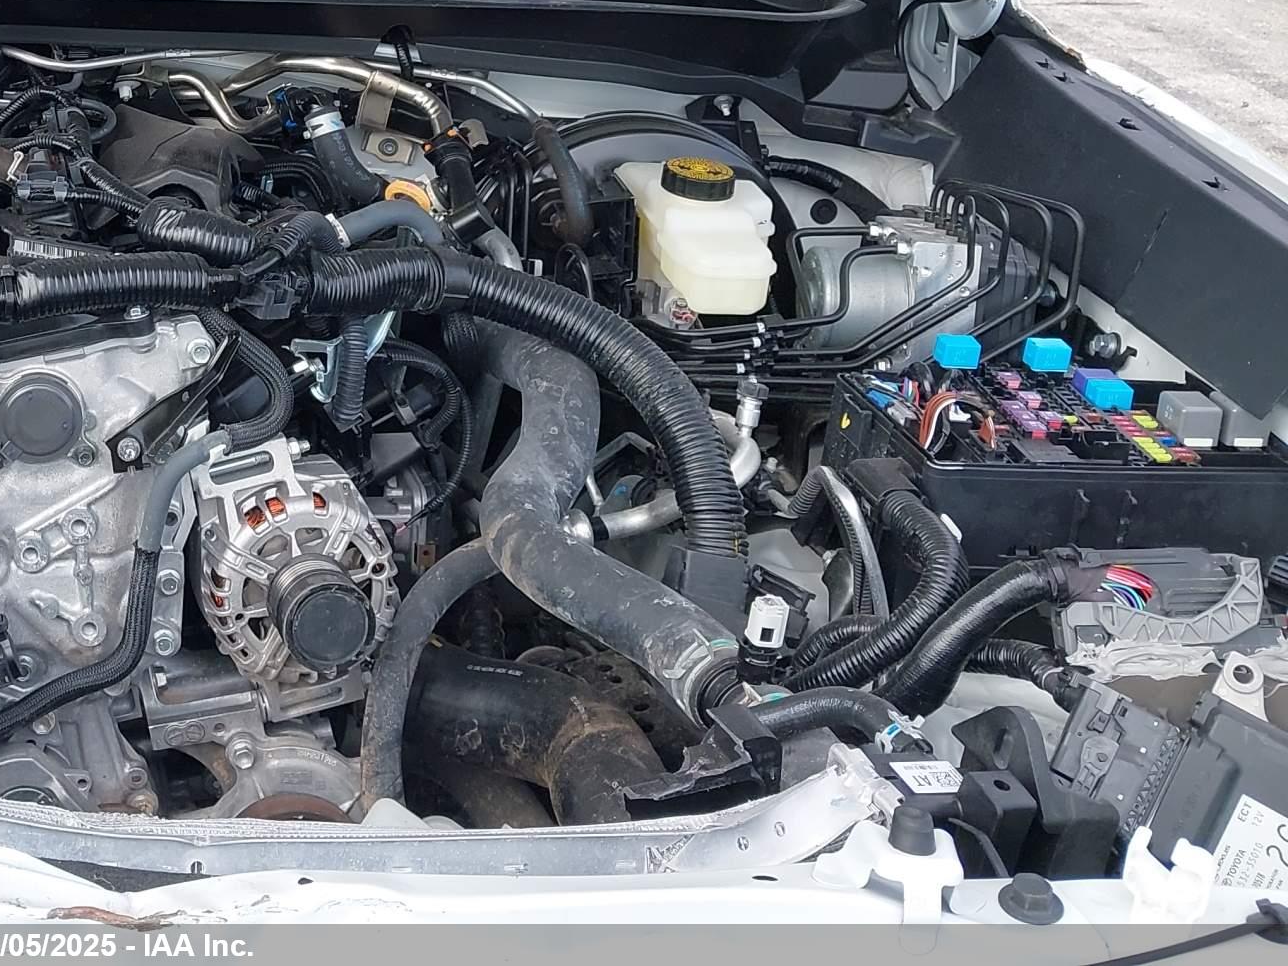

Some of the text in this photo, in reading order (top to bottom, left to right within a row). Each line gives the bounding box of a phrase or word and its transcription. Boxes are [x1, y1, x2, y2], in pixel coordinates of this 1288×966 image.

[912, 775, 932, 786] AT
[1237, 801, 1252, 822] ECT
[1227, 849, 1247, 878] TOYOTA
